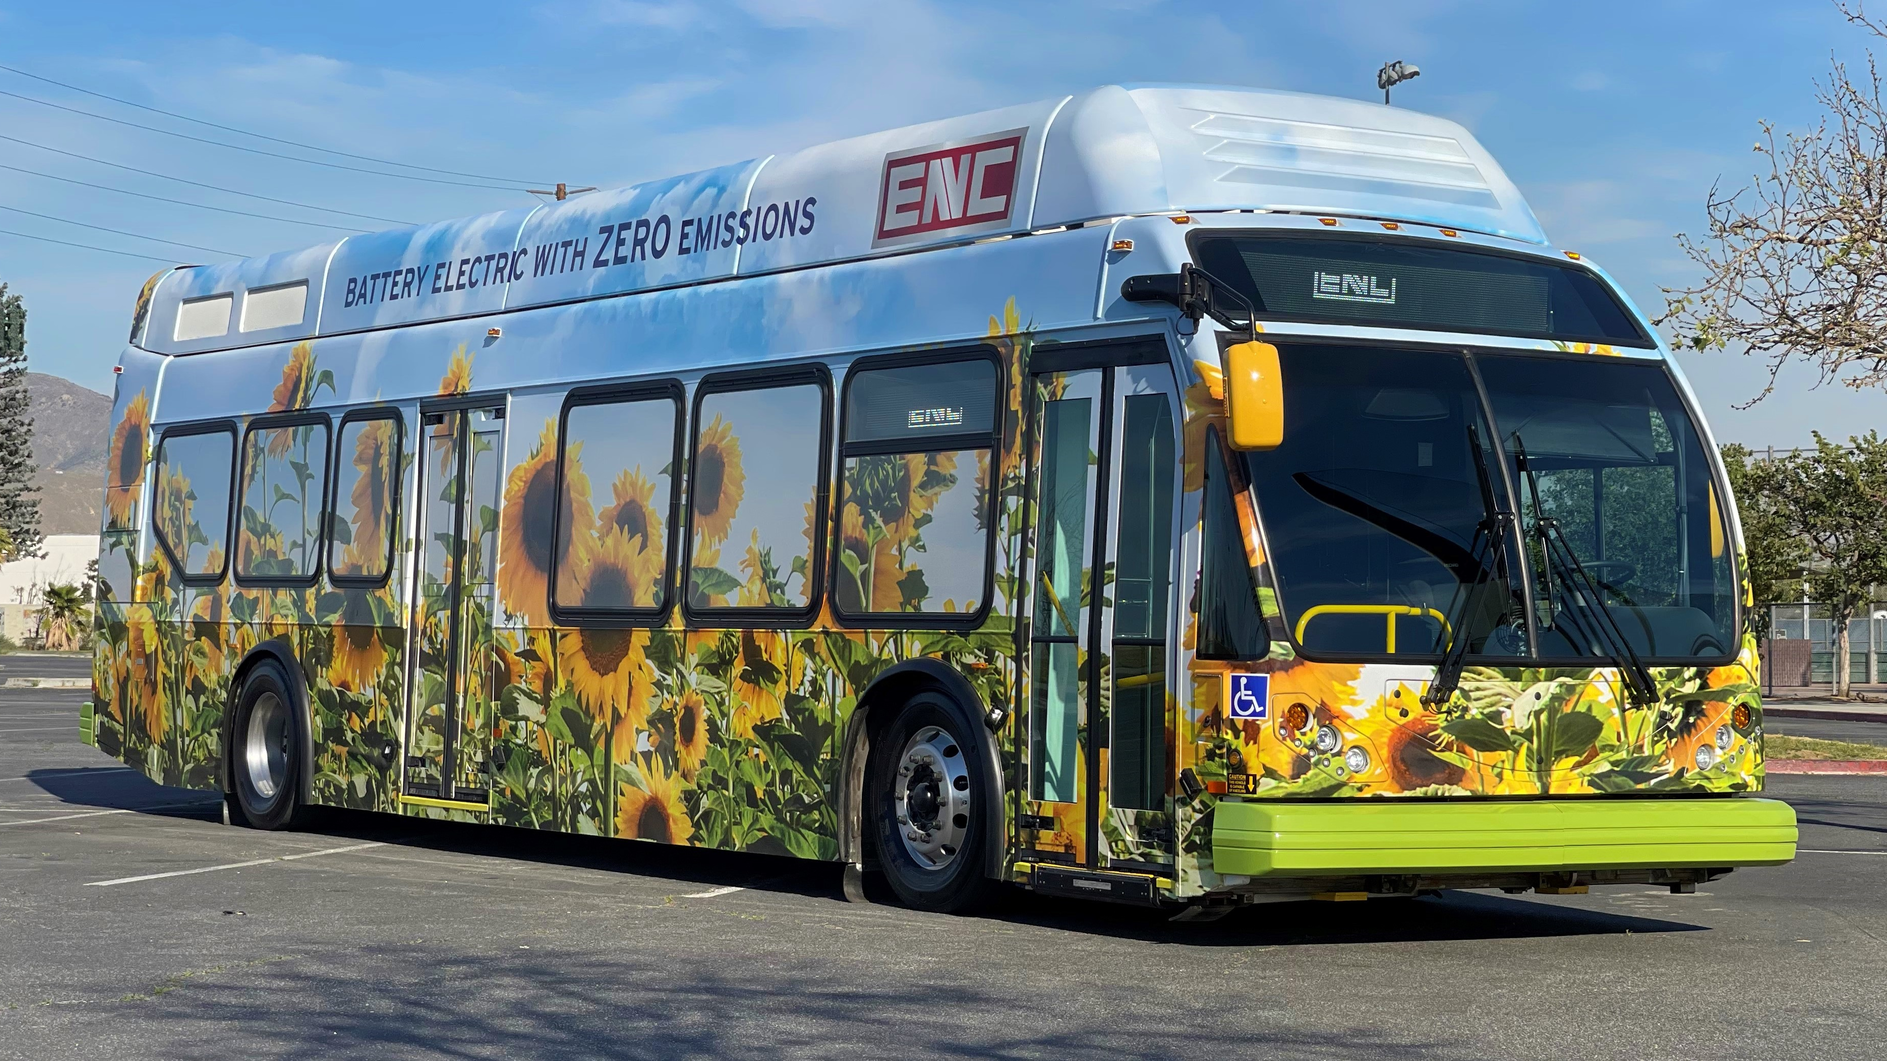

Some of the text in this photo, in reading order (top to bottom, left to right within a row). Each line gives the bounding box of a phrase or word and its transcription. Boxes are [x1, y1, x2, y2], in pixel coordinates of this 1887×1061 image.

[882, 145, 1015, 231] ENC
[344, 196, 817, 308] BATTERY ELECTRIC WITH ZERO EMISSIONS
